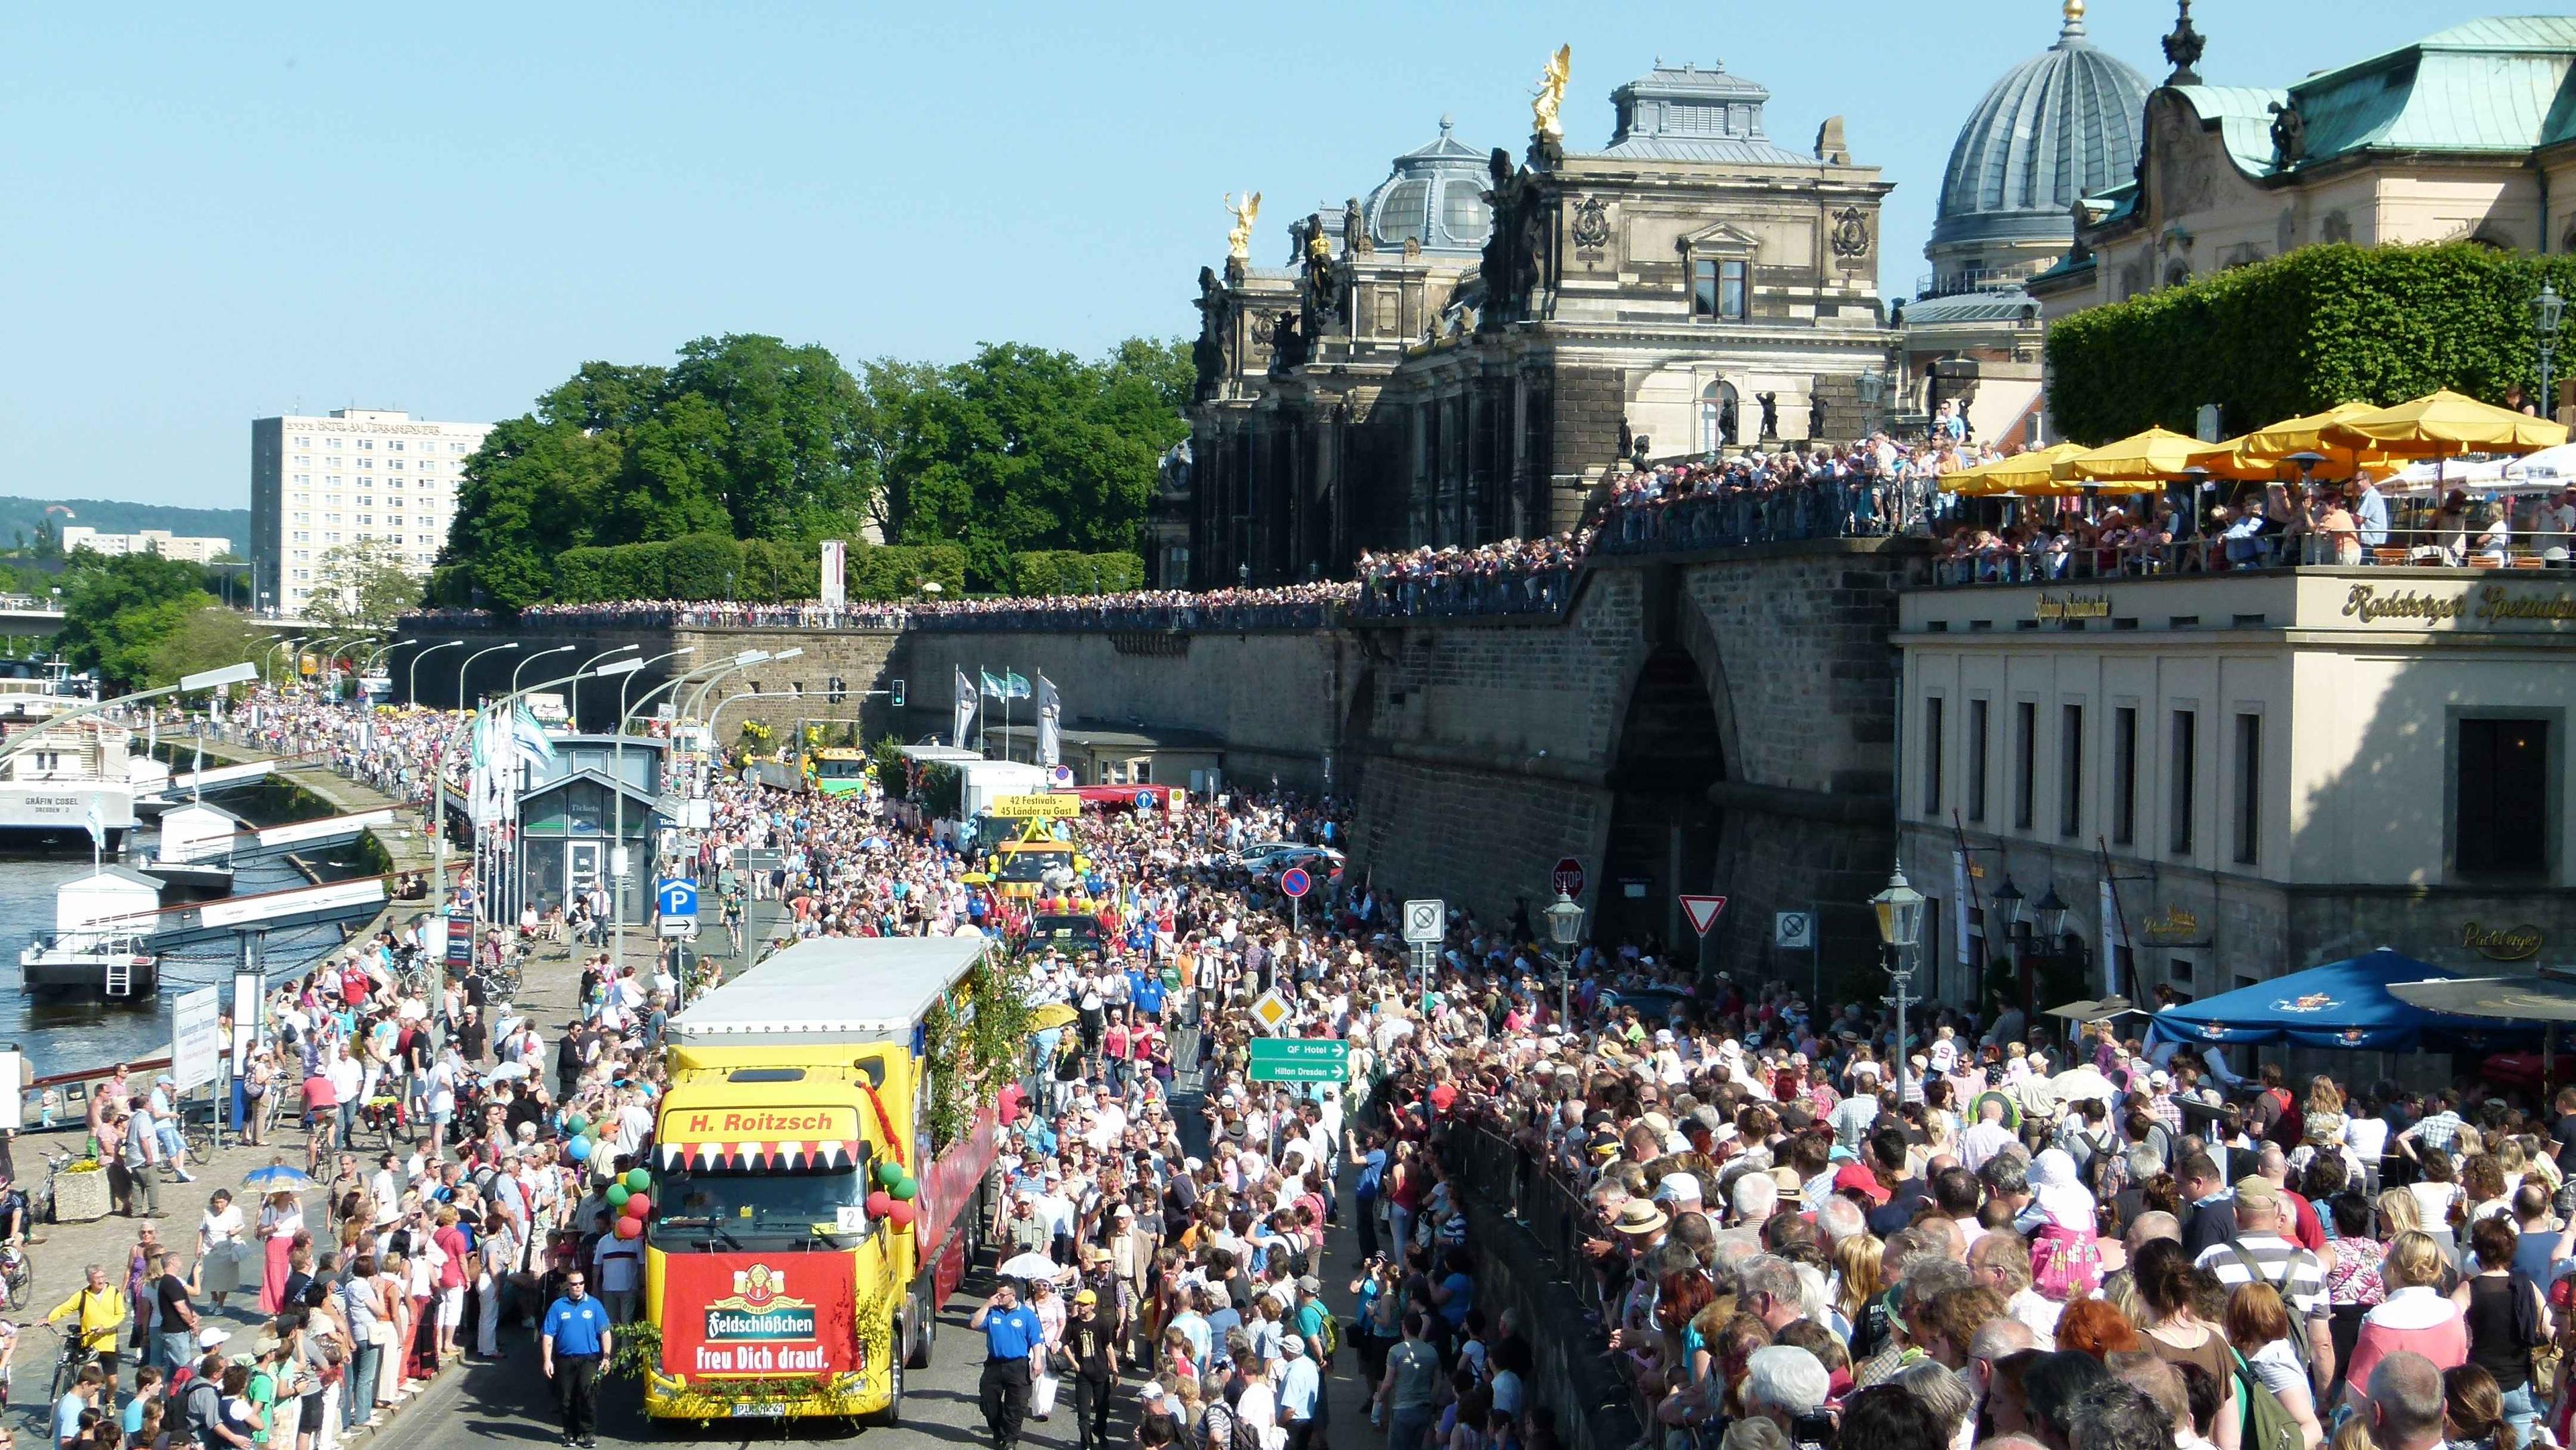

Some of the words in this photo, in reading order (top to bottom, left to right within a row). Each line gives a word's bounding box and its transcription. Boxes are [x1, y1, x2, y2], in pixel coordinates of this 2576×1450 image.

[2341, 583, 2466, 627] Radeberger
[25, 796, 52, 805] GRÄFIN
[1010, 796, 1020, 805] 42
[1022, 795, 1057, 805] Festivals
[1001, 807, 1011, 816] 45
[1013, 805, 1040, 816] Länder
[1054, 807, 1072, 816] Gast
[1555, 871, 1582, 888] STOP
[671, 891, 688, 913] P
[1287, 1046, 1300, 1054] QF
[1304, 1046, 1327, 1054] Hotel
[1939, 1047, 1950, 1059] 9
[1275, 1067, 1295, 1075] Hilton
[1298, 1068, 1327, 1076] Dresden
[689, 1115, 714, 1132] H.
[723, 1113, 833, 1131] Roitzsch
[847, 1211, 855, 1227] 2
[742, 1303, 775, 1314] Dresdner
[708, 1310, 813, 1338] Feldschlößchen
[696, 1345, 732, 1370] Freu
[737, 1345, 773, 1370] Dich
[777, 1345, 830, 1370] drauf.
